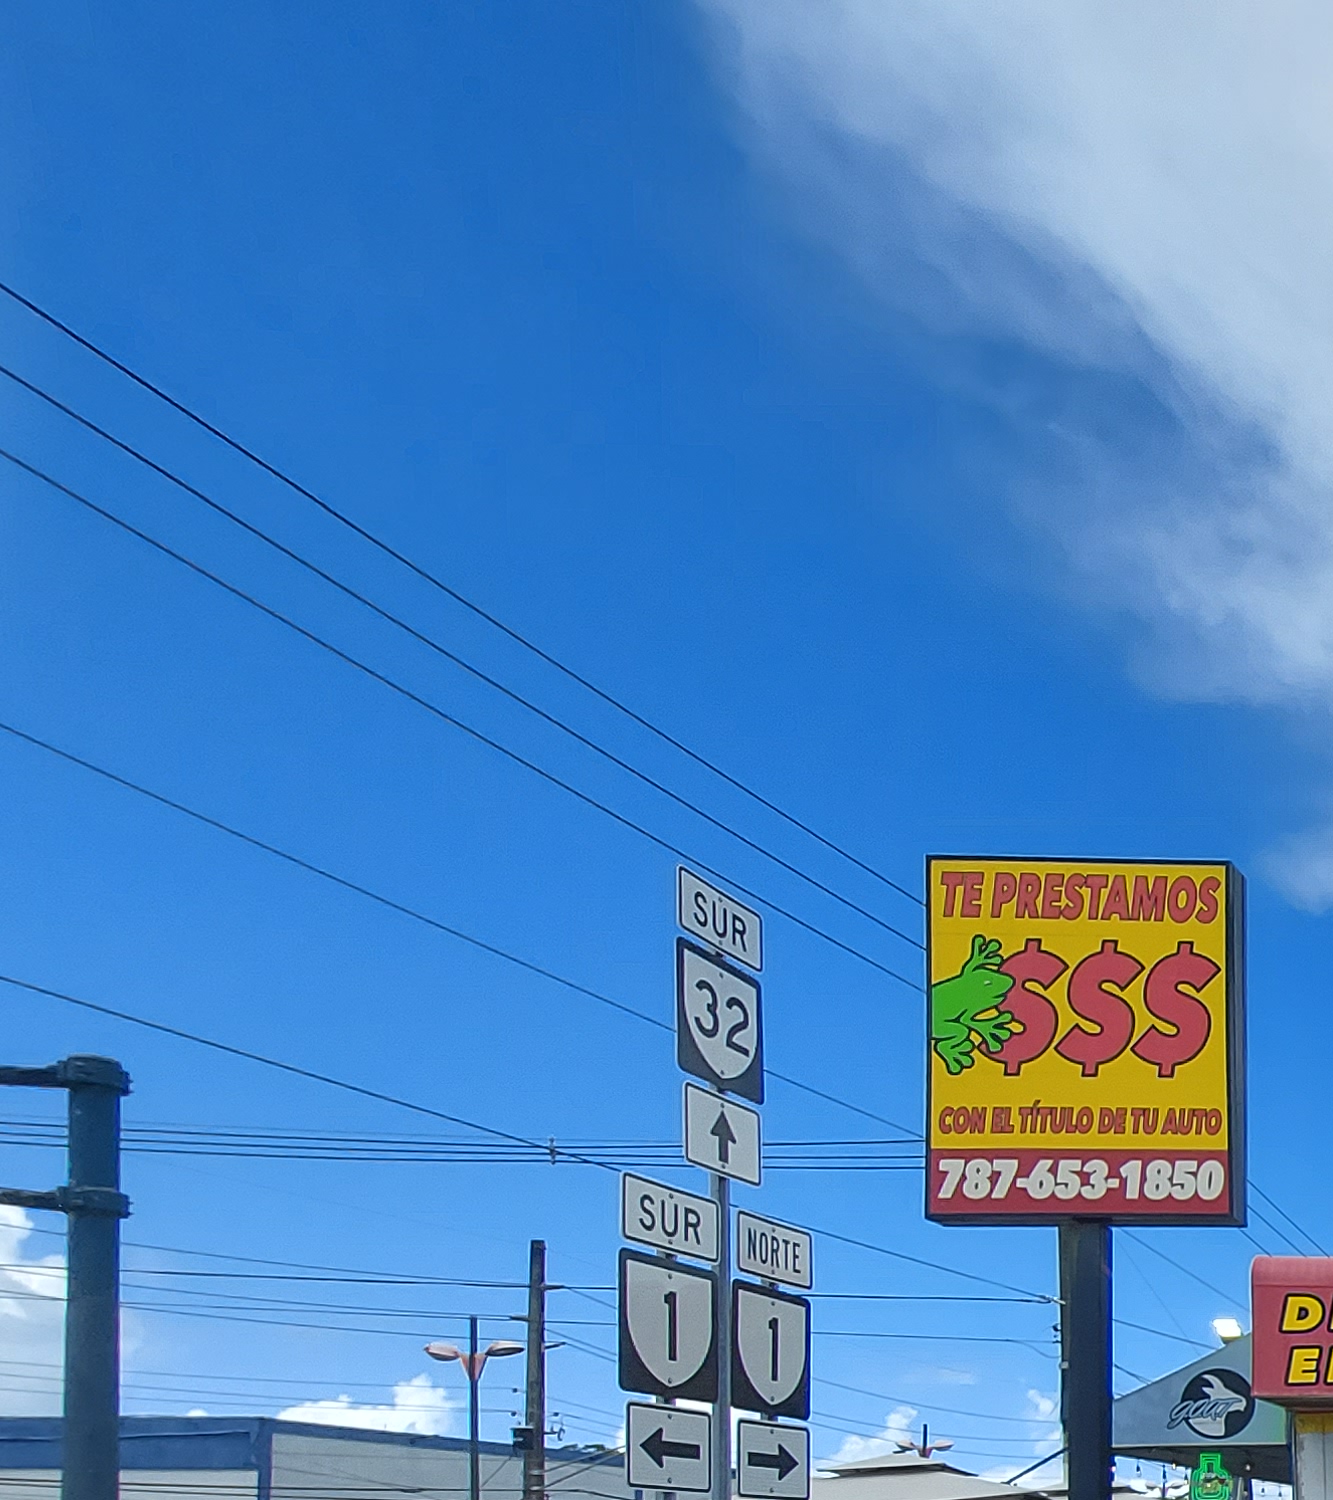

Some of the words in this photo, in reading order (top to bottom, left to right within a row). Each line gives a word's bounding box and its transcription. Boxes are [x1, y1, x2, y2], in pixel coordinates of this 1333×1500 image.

[693, 890, 748, 954] SUR
[940, 870, 985, 919] TE
[990, 871, 1222, 924] PRESTAMOS
[693, 978, 751, 1058] 32
[939, 1105, 986, 1135] CON
[990, 1105, 1015, 1135] EL
[1019, 1099, 1094, 1136] TÍTULO
[1098, 1106, 1125, 1136] DE
[1130, 1107, 1161, 1136] TU
[1162, 1107, 1223, 1137] AUTO
[937, 1158, 1226, 1201] 787-653-1850
[638, 1194, 702, 1246] SUR
[746, 1228, 802, 1275] NORTE
[663, 1290, 677, 1362] 1
[767, 1316, 779, 1382] 1
